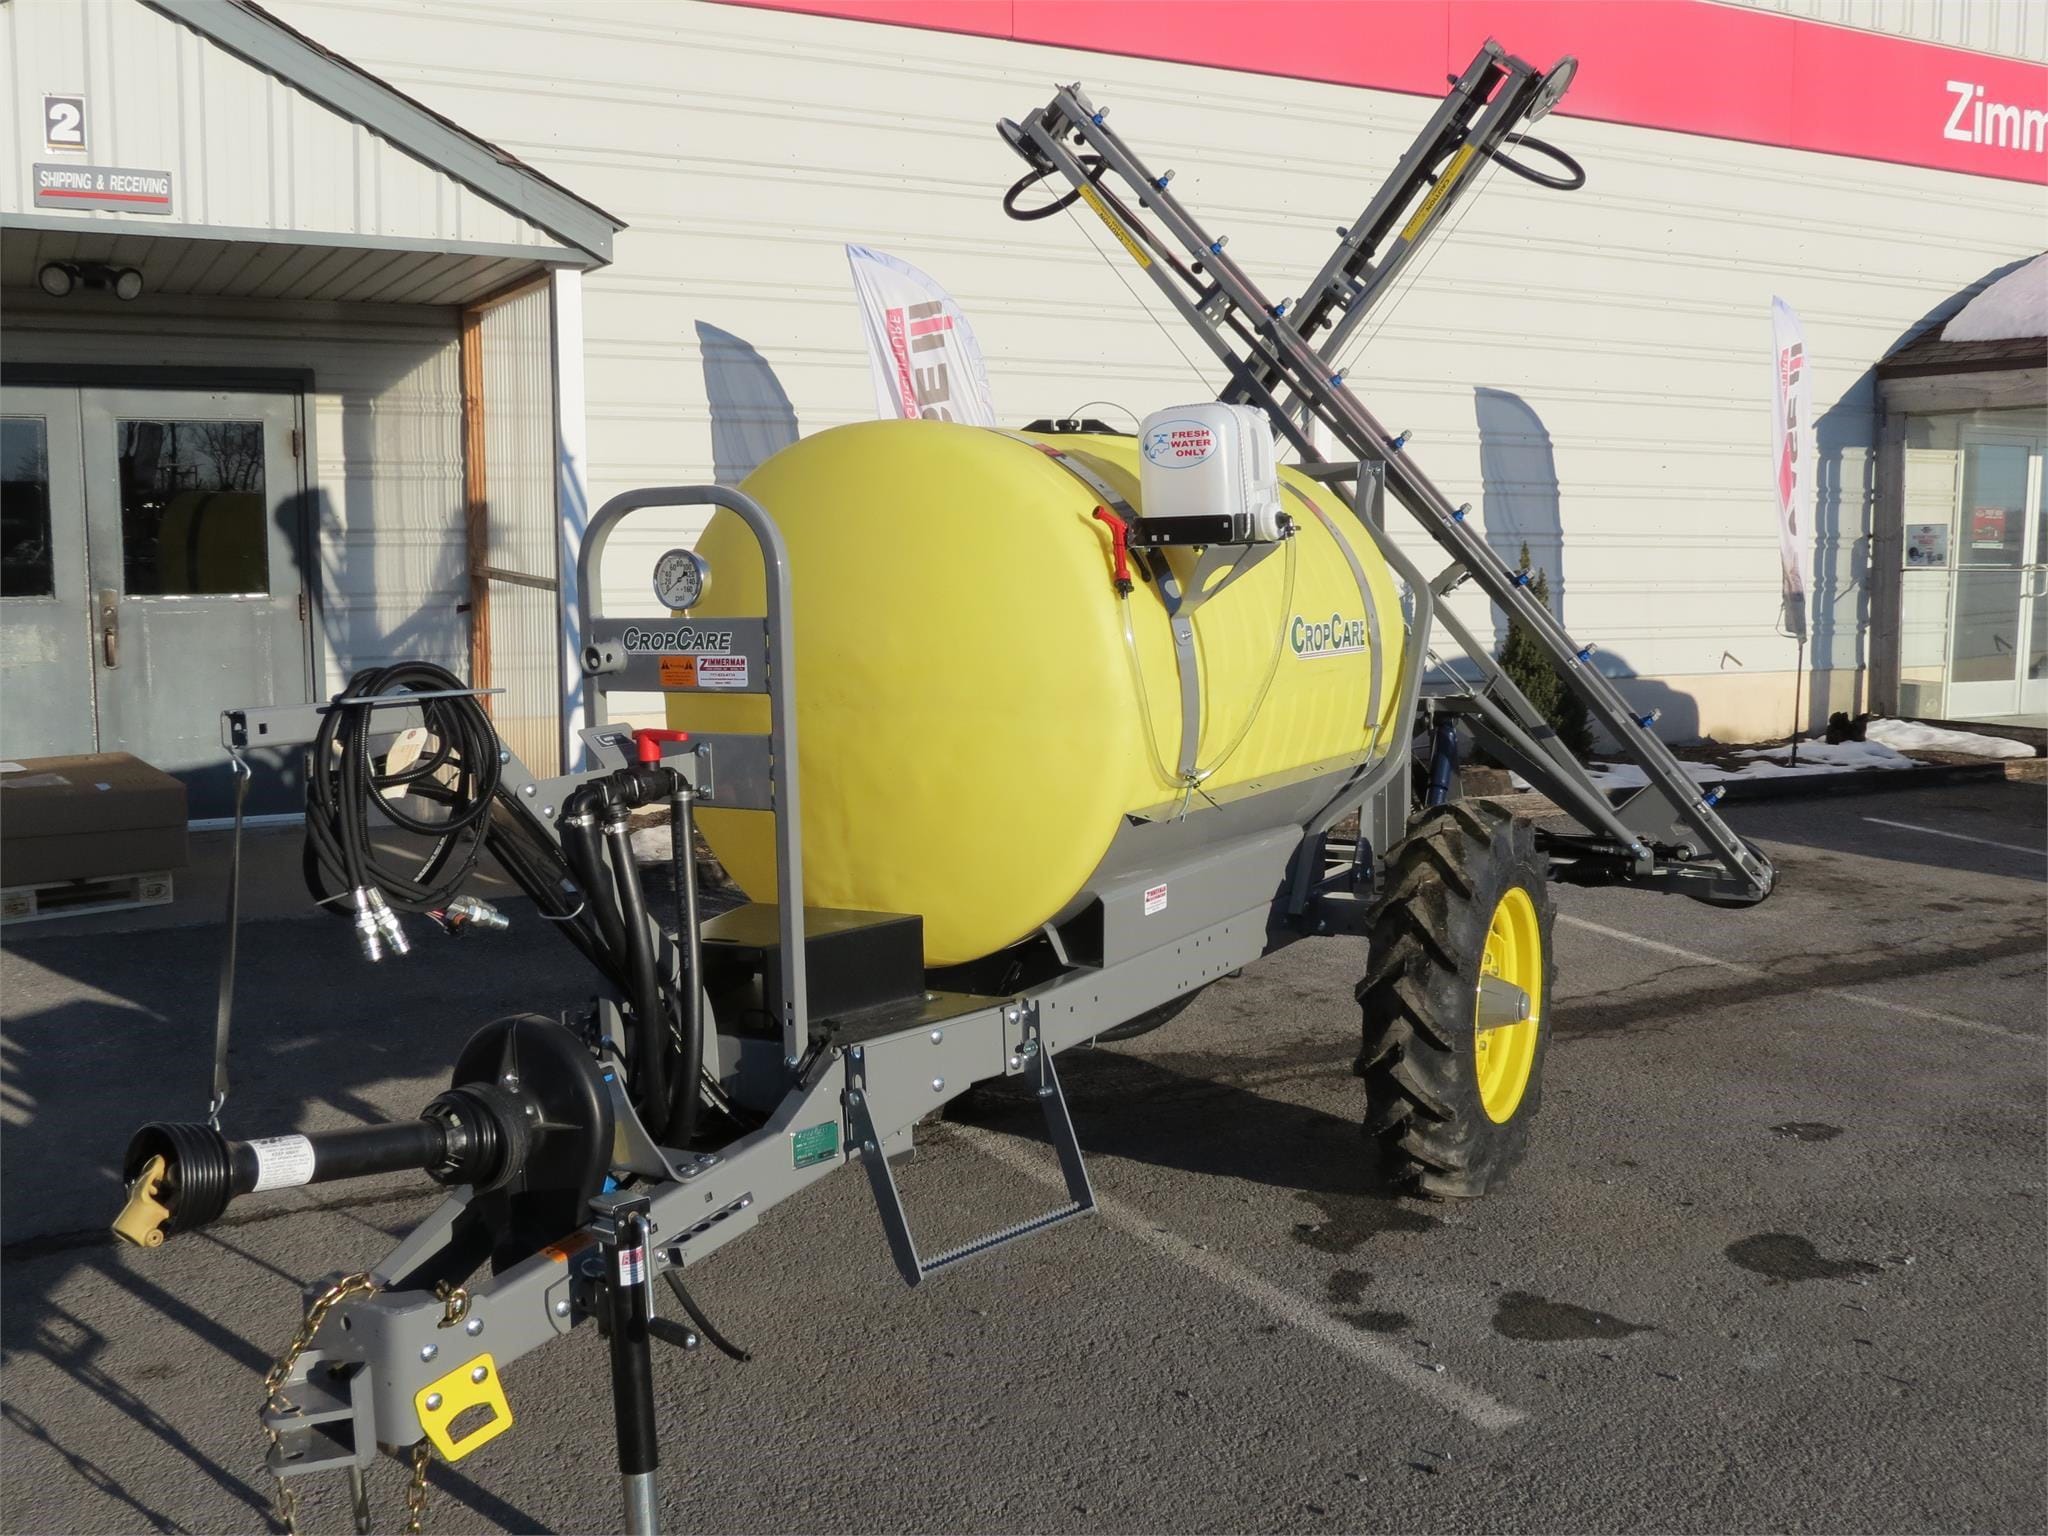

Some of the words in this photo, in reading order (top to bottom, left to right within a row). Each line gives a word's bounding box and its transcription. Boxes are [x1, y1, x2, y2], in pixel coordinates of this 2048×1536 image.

[48, 102, 81, 142] 2
[39, 170, 92, 190] SHIPPING
[95, 174, 105, 190] &
[109, 174, 168, 194] RECEIVING
[1171, 429, 1210, 439] FRESH
[1170, 439, 1212, 448] WATER
[1175, 448, 1207, 457] ONLY
[699, 658, 746, 672] ZIMMERMAN
